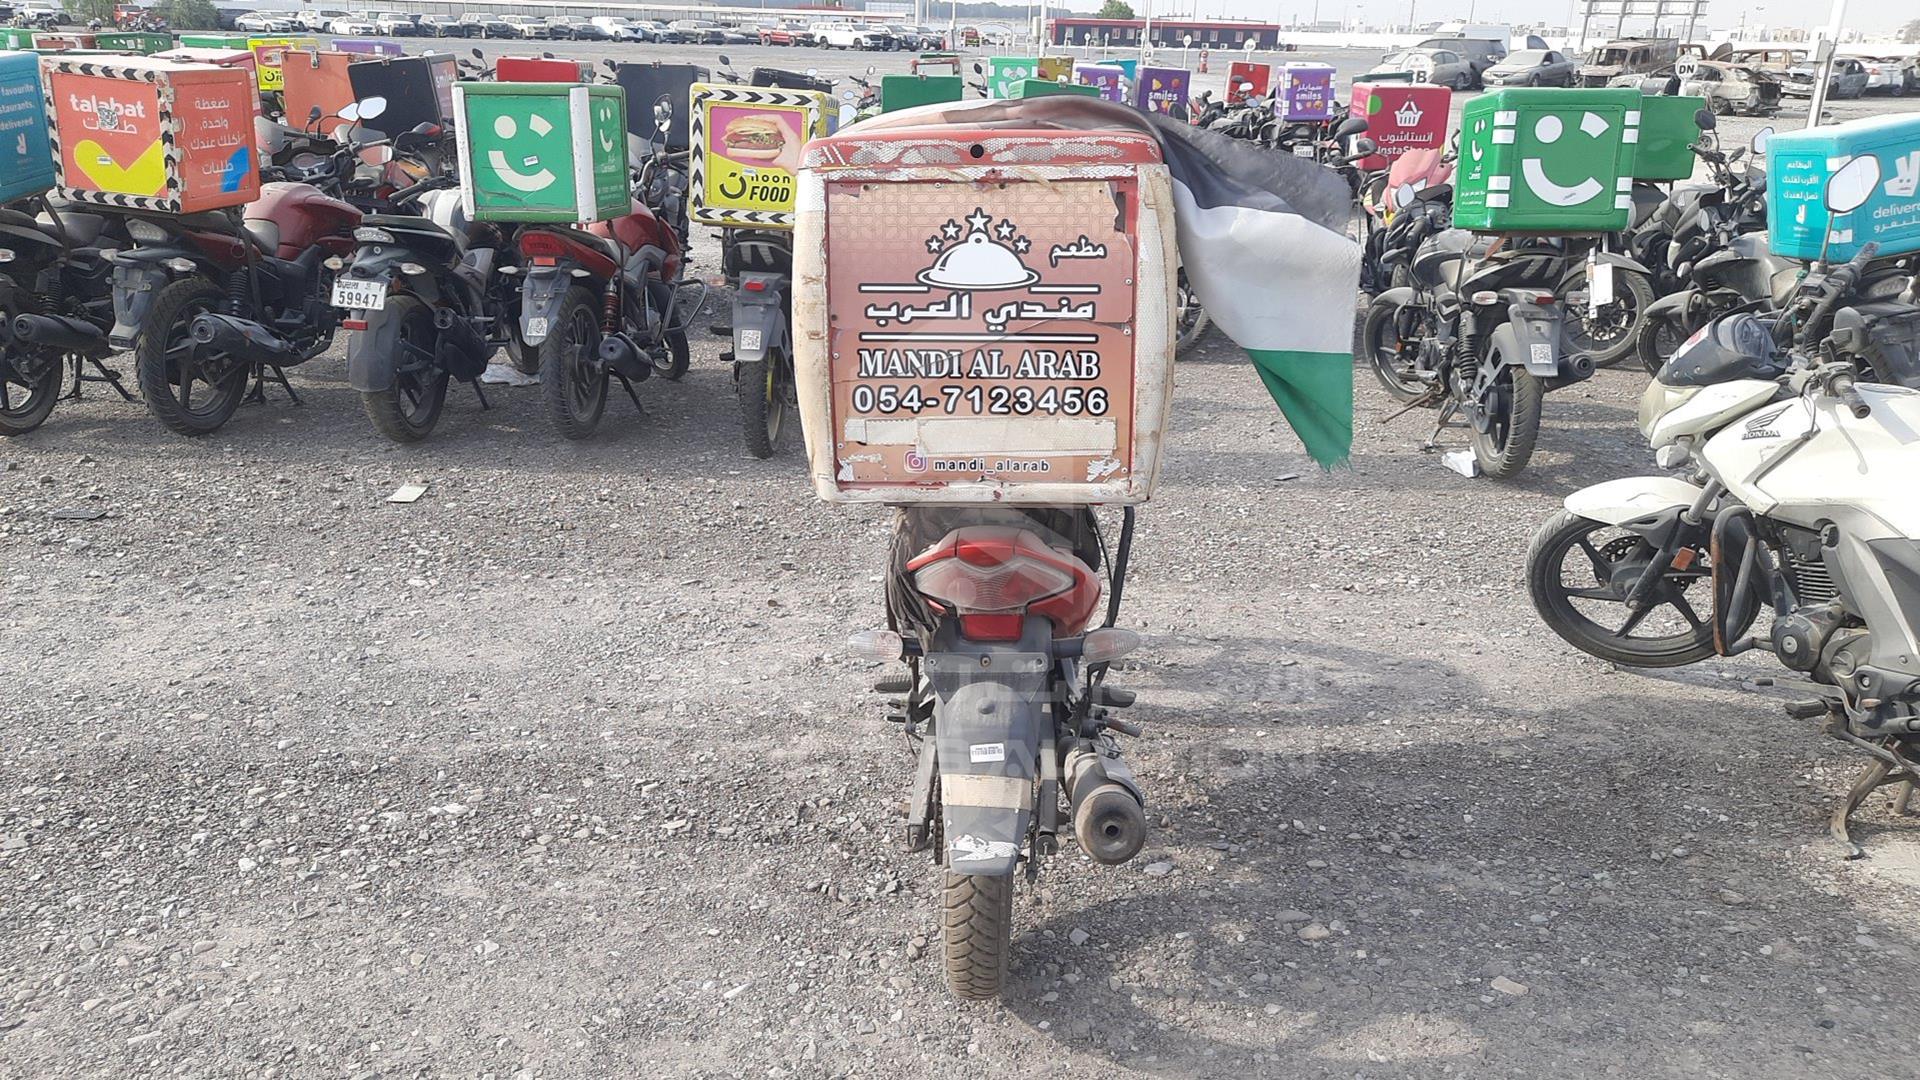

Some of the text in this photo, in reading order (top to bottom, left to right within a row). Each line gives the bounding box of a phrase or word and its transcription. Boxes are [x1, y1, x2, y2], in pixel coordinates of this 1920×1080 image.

[1679, 65, 1695, 75] DN
[1148, 90, 1179, 101] smiles
[1296, 91, 1322, 100] smiles
[69, 93, 146, 119] talabat
[202, 160, 234, 175] طلبات
[751, 174, 791, 184] noon
[749, 186, 790, 203] FOOD
[1051, 238, 1105, 266] مطعم
[339, 291, 377, 308] 59947
[866, 291, 1095, 332] مندي العرب
[858, 349, 1099, 381] MANDI AL ARAB
[853, 385, 1107, 415] 054-7123456
[1742, 430, 1781, 440] HONDA
[934, 457, 1049, 475] mandi_alarab
